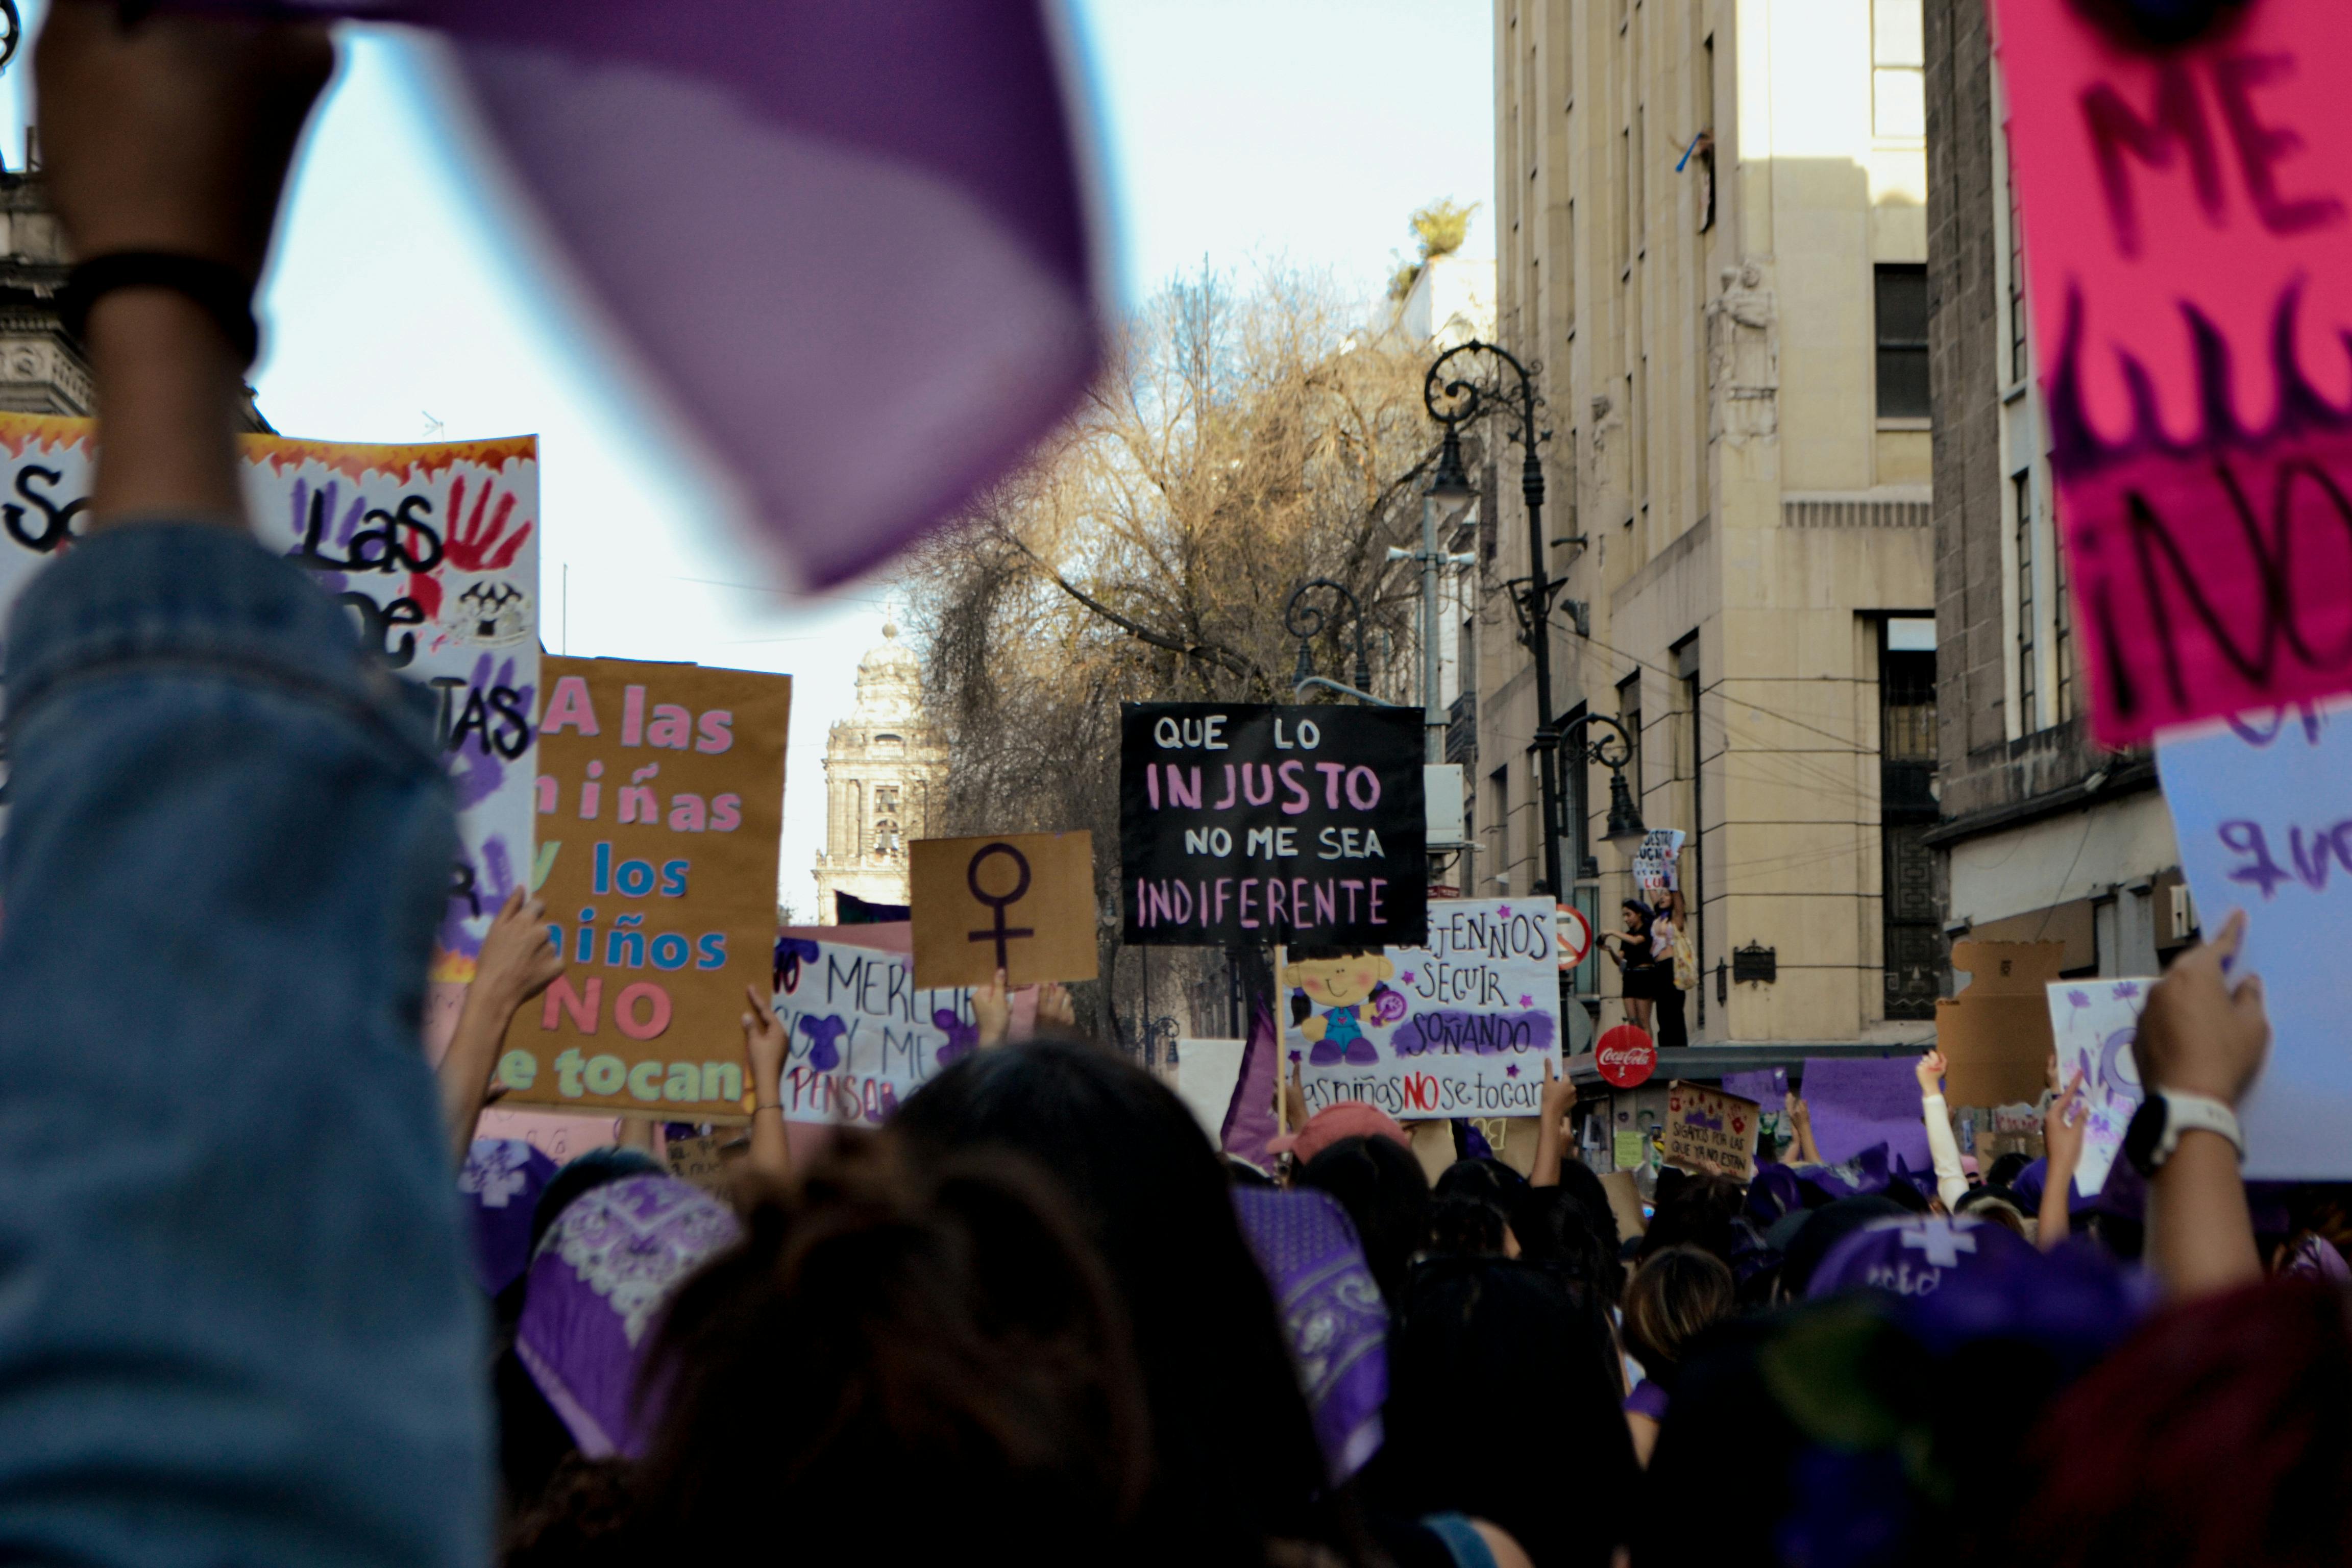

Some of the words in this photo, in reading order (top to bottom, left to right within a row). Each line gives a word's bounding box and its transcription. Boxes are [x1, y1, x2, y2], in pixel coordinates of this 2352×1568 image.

[2077, 50, 2350, 261] ME
[540, 676, 600, 736] A
[621, 685, 733, 754] las
[1154, 716, 1229, 750] QUE
[1275, 718, 1320, 750] LO
[1147, 760, 1381, 815] INJUSTO
[1185, 826, 1232, 857] NO
[1246, 826, 1298, 860] ME
[1317, 827, 1386, 860] SEA
[593, 841, 690, 897] los
[1137, 877, 1389, 929] INDIFERENTE
[541, 973, 672, 1041] NO
[1415, 962, 1509, 1007] SEGUIR
[1406, 1012, 1531, 1057] SOÑANDO
[1333, 1075, 1404, 1115] niñas
[1404, 1070, 1439, 1112] NO
[1441, 1078, 1472, 1111] se
[1672, 1140, 1691, 1157] QUE
[1694, 1145, 1705, 1159] YA
[1706, 1147, 1719, 1161] NO
[1673, 1121, 1709, 1143] SIGAMOS
[1711, 1130, 1728, 1146] POR
[1730, 1136, 1745, 1152] LAS
